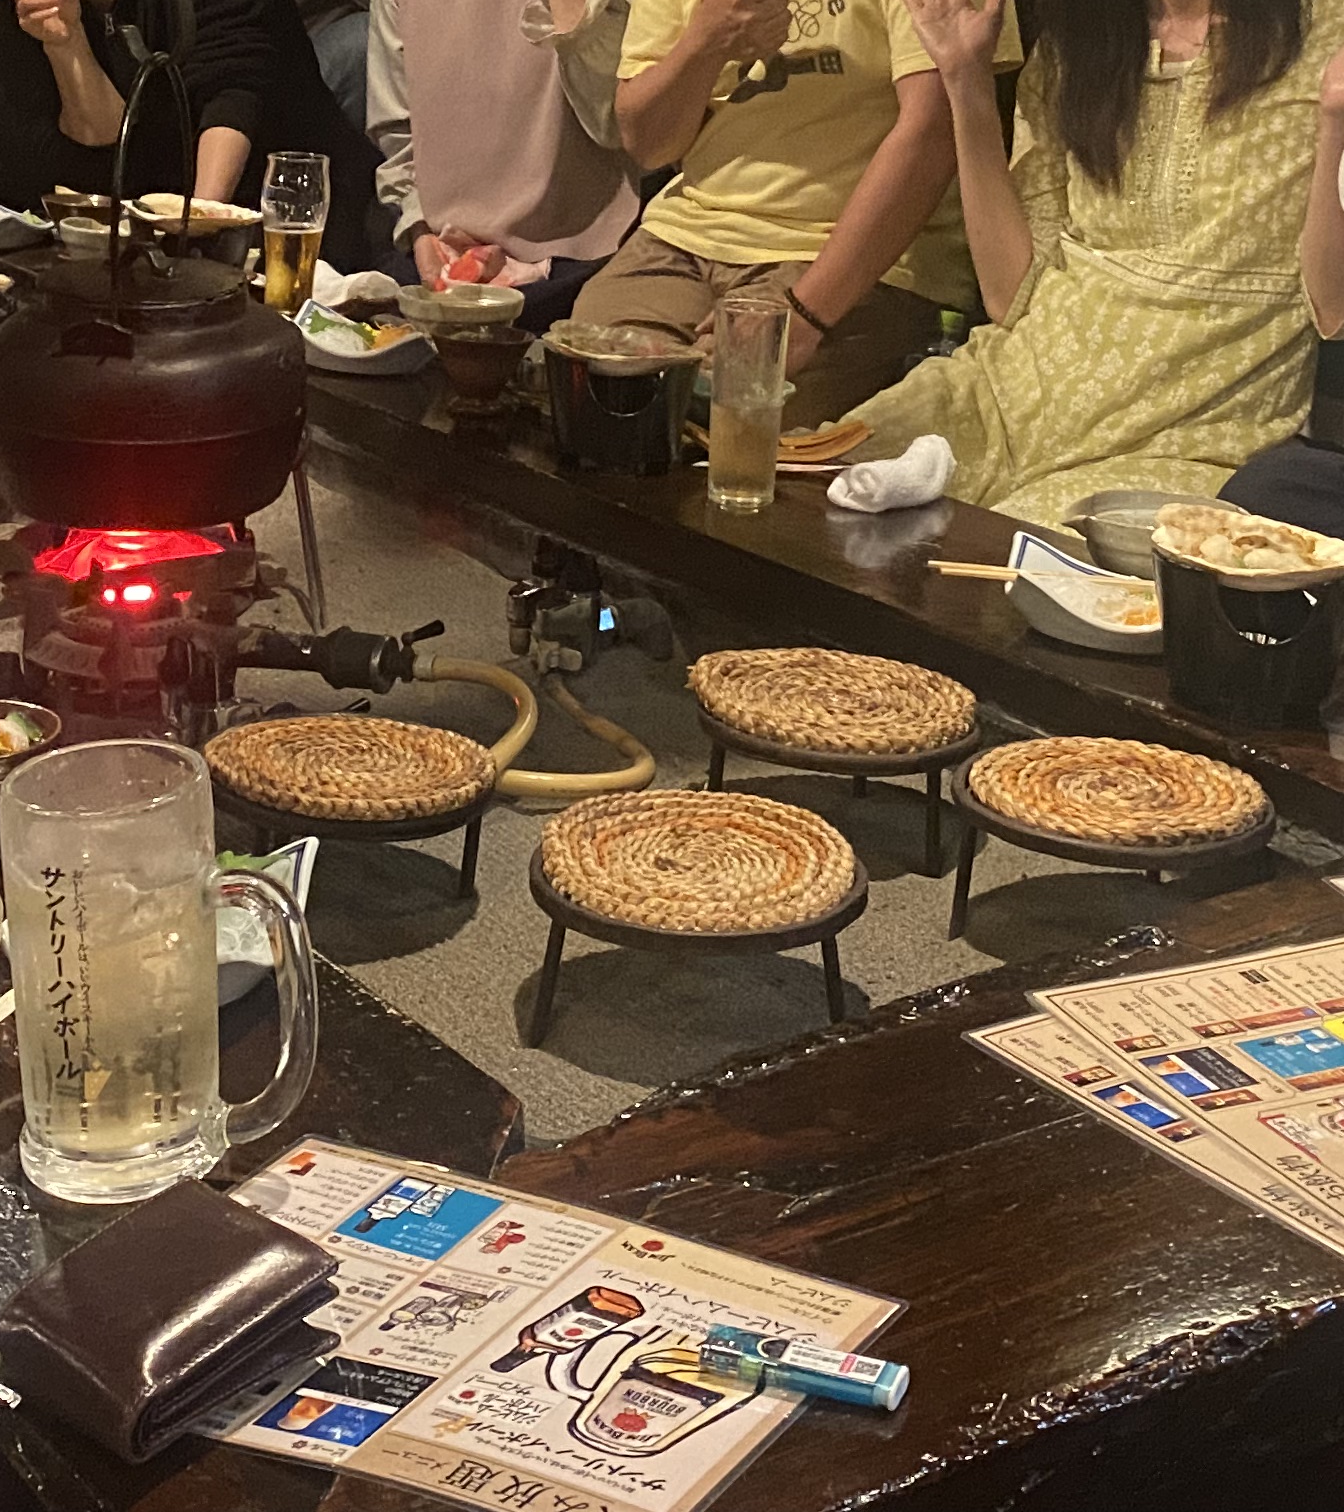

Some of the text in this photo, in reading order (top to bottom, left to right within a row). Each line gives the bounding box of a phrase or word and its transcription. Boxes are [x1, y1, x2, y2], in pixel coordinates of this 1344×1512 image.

[40, 866, 82, 1080] サントリーハイボール
[593, 1268, 820, 1345] ジムビームハイボール
[765, 1276, 854, 1308] ジムビーム
[622, 1388, 687, 1414] BOURBON
[309, 1443, 347, 1457] ビール
[465, 1421, 666, 1491] サントリーハイボール
